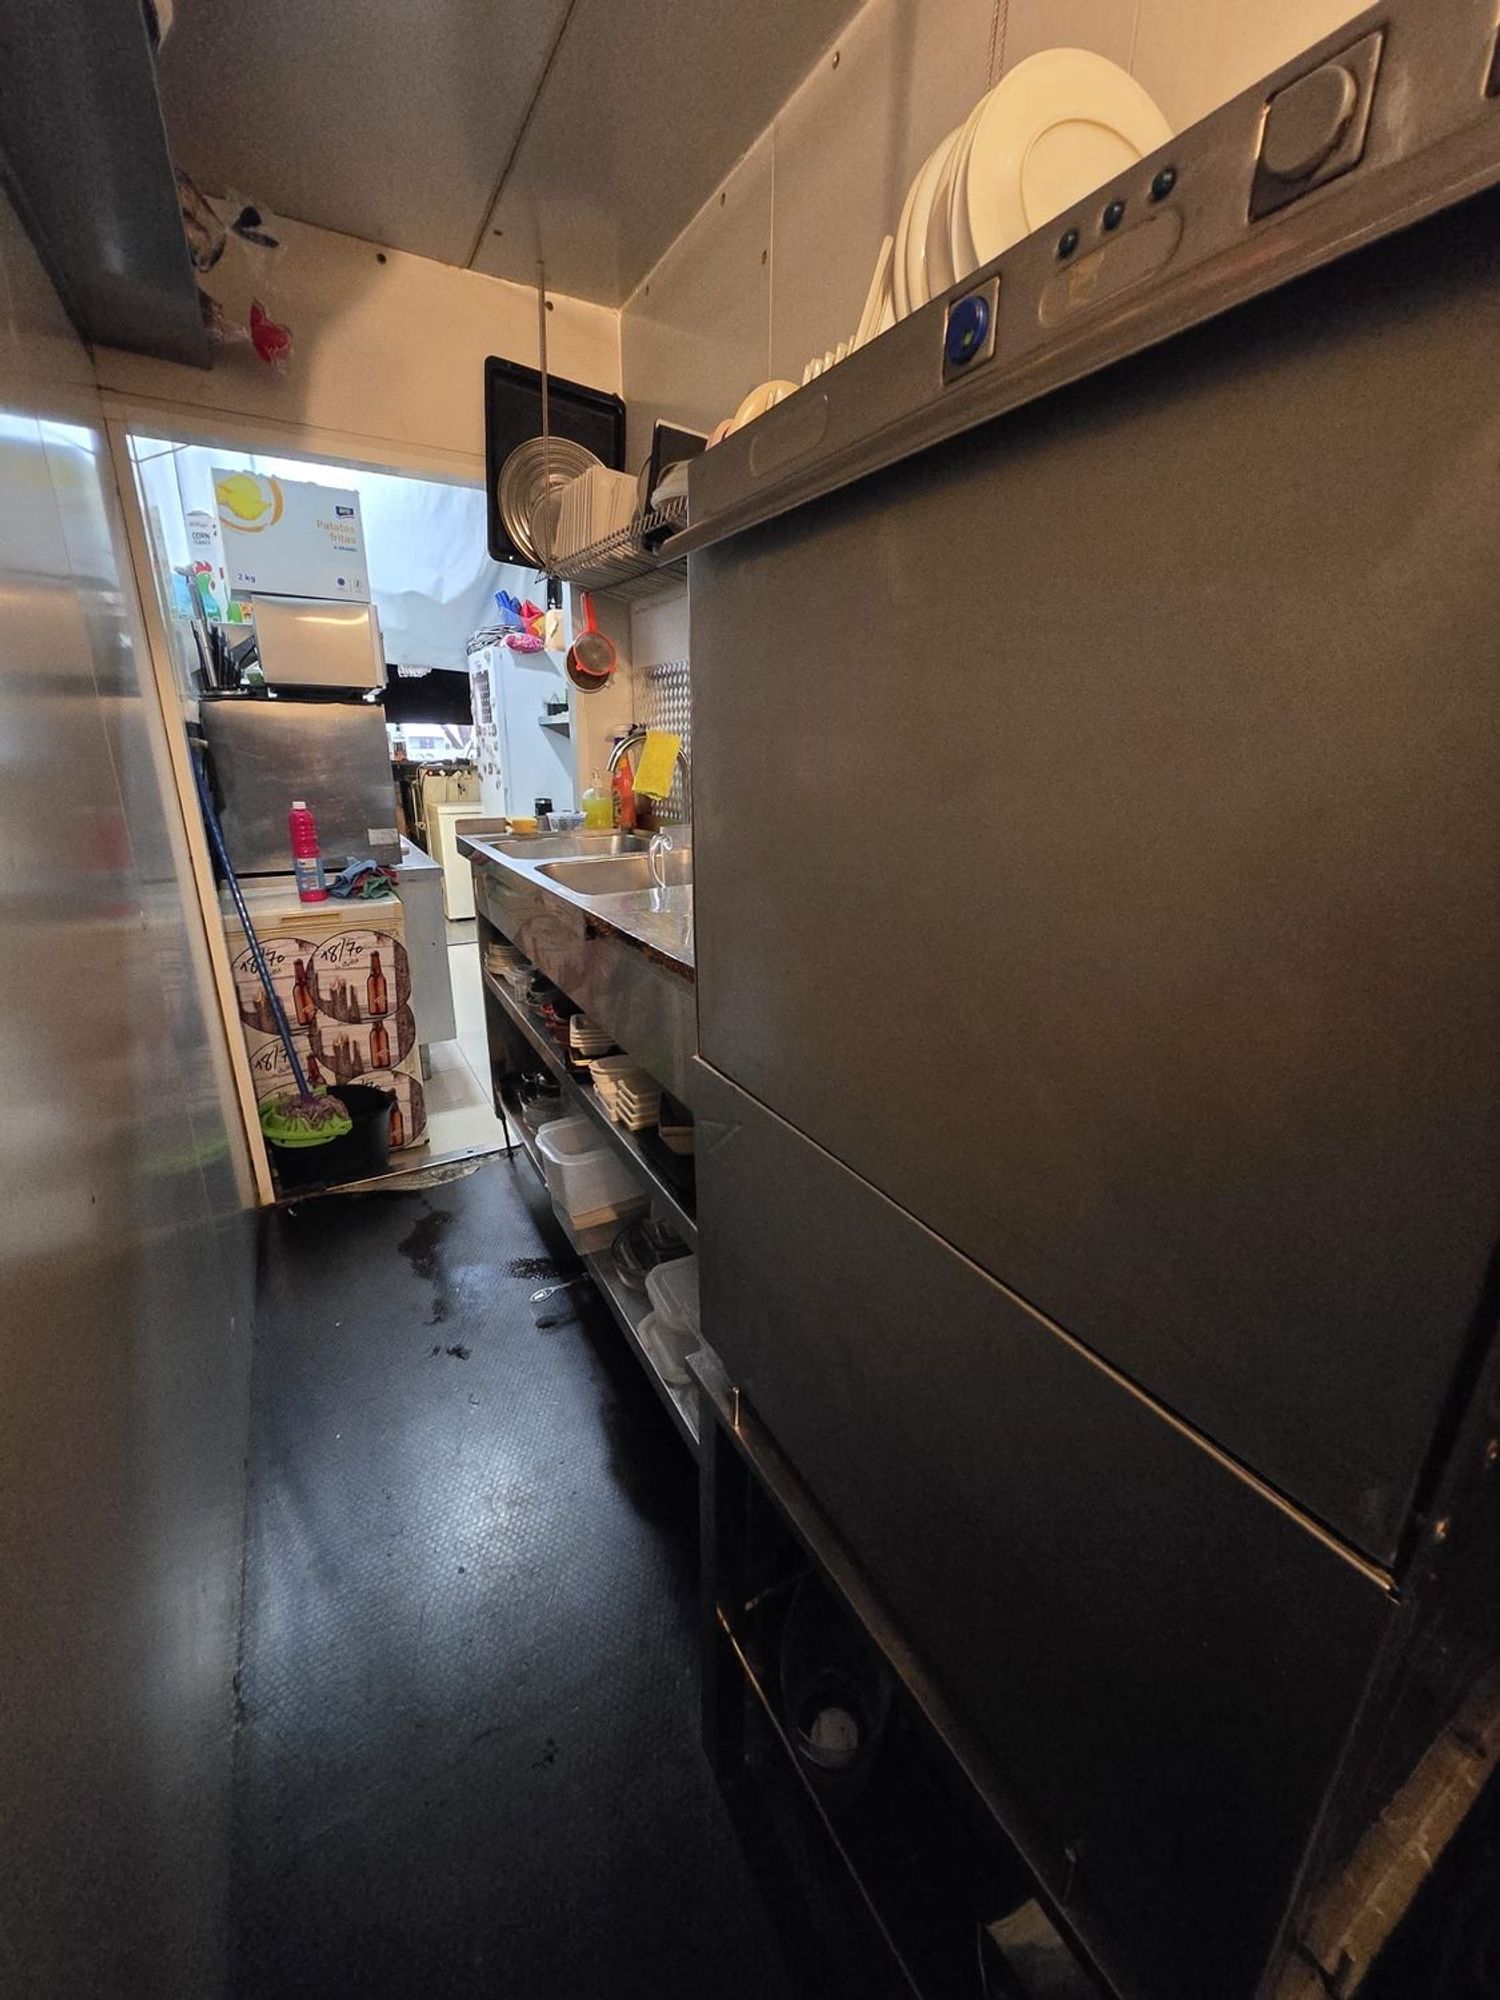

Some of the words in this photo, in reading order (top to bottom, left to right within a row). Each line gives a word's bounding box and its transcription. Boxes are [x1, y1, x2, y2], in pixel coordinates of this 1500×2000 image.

[316, 519, 356, 533] Patatas
[192, 531, 210, 540] CORN
[237, 572, 243, 581] 2
[245, 573, 256, 584] kg
[321, 939, 363, 963] 18/70
[255, 1045, 290, 1072] 18/7
